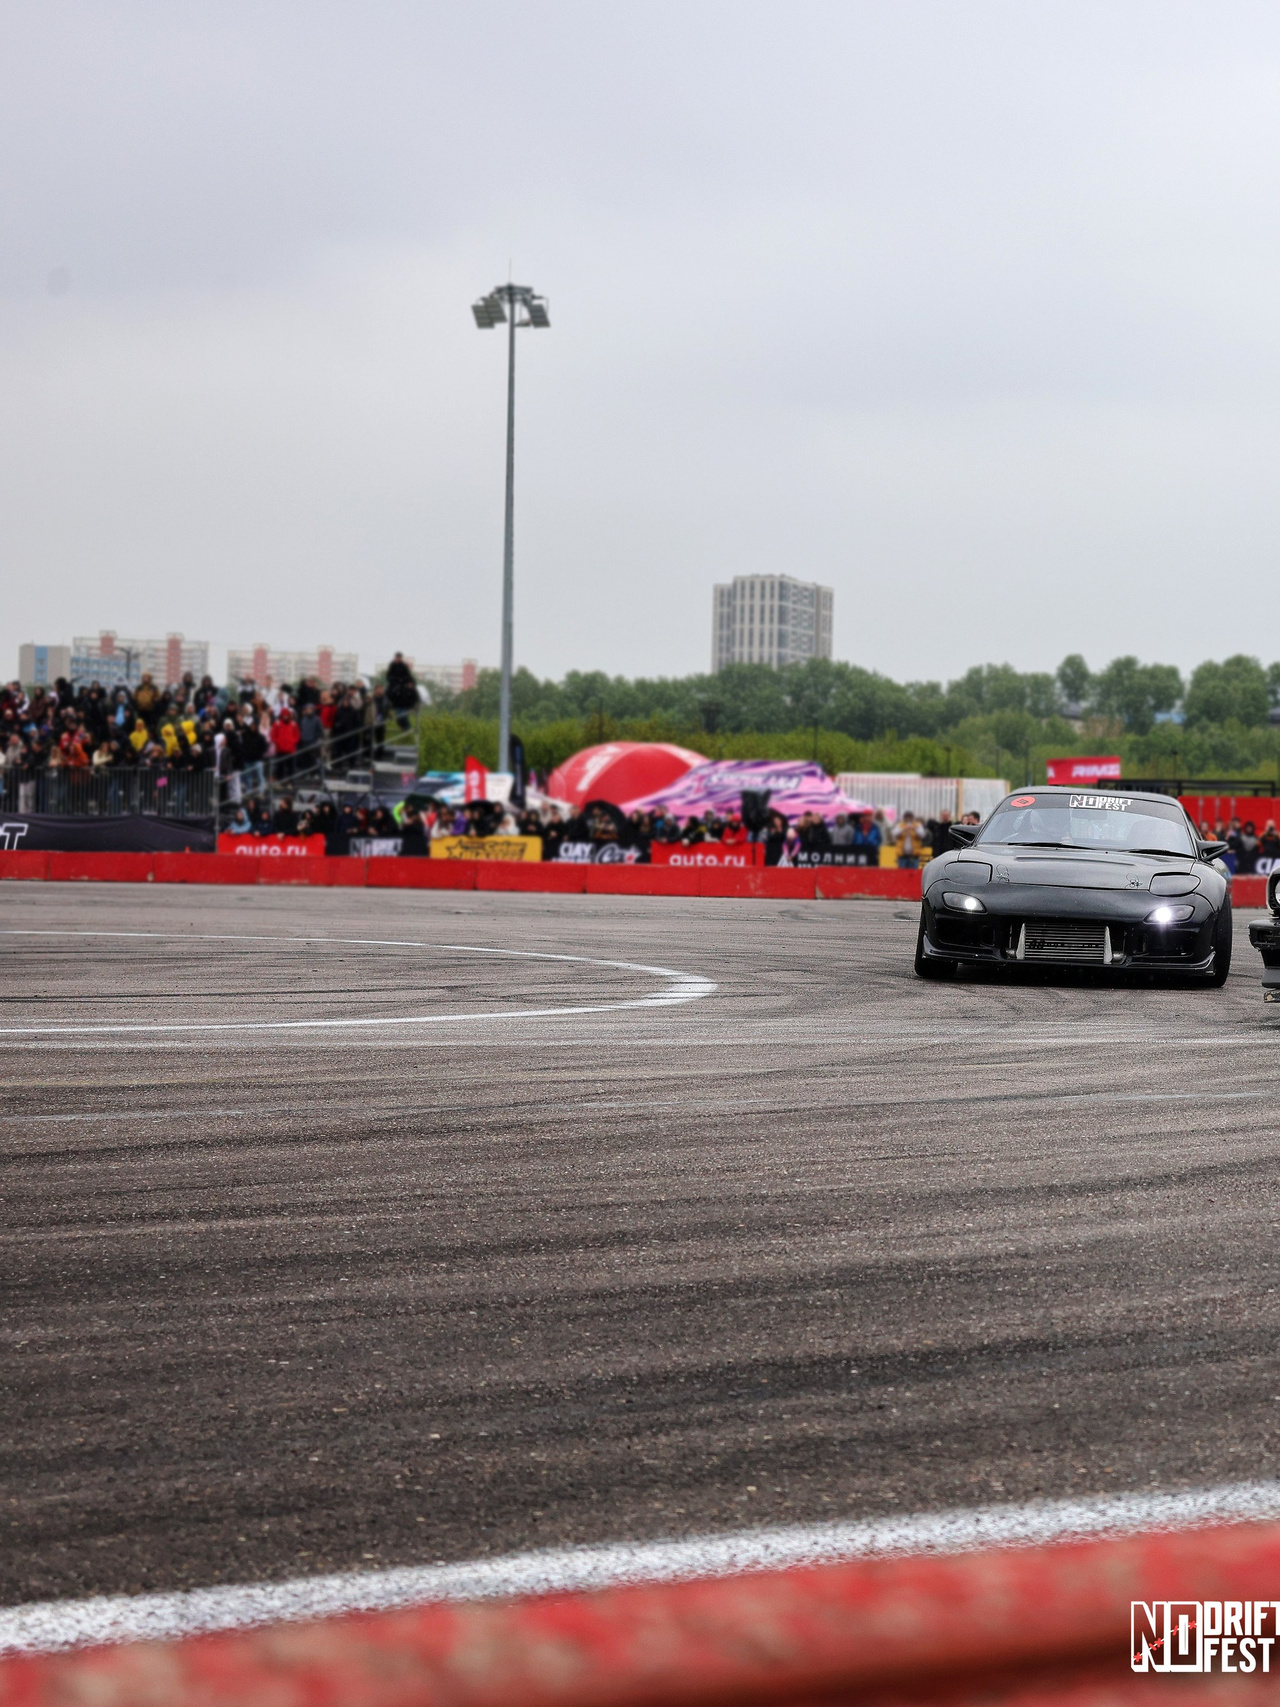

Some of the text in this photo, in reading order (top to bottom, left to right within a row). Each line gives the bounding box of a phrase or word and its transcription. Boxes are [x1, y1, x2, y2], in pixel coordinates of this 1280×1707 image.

[1099, 796, 1133, 806] DRIFT
[1099, 803, 1127, 811] FEST
[669, 853, 745, 866] auto.ru
